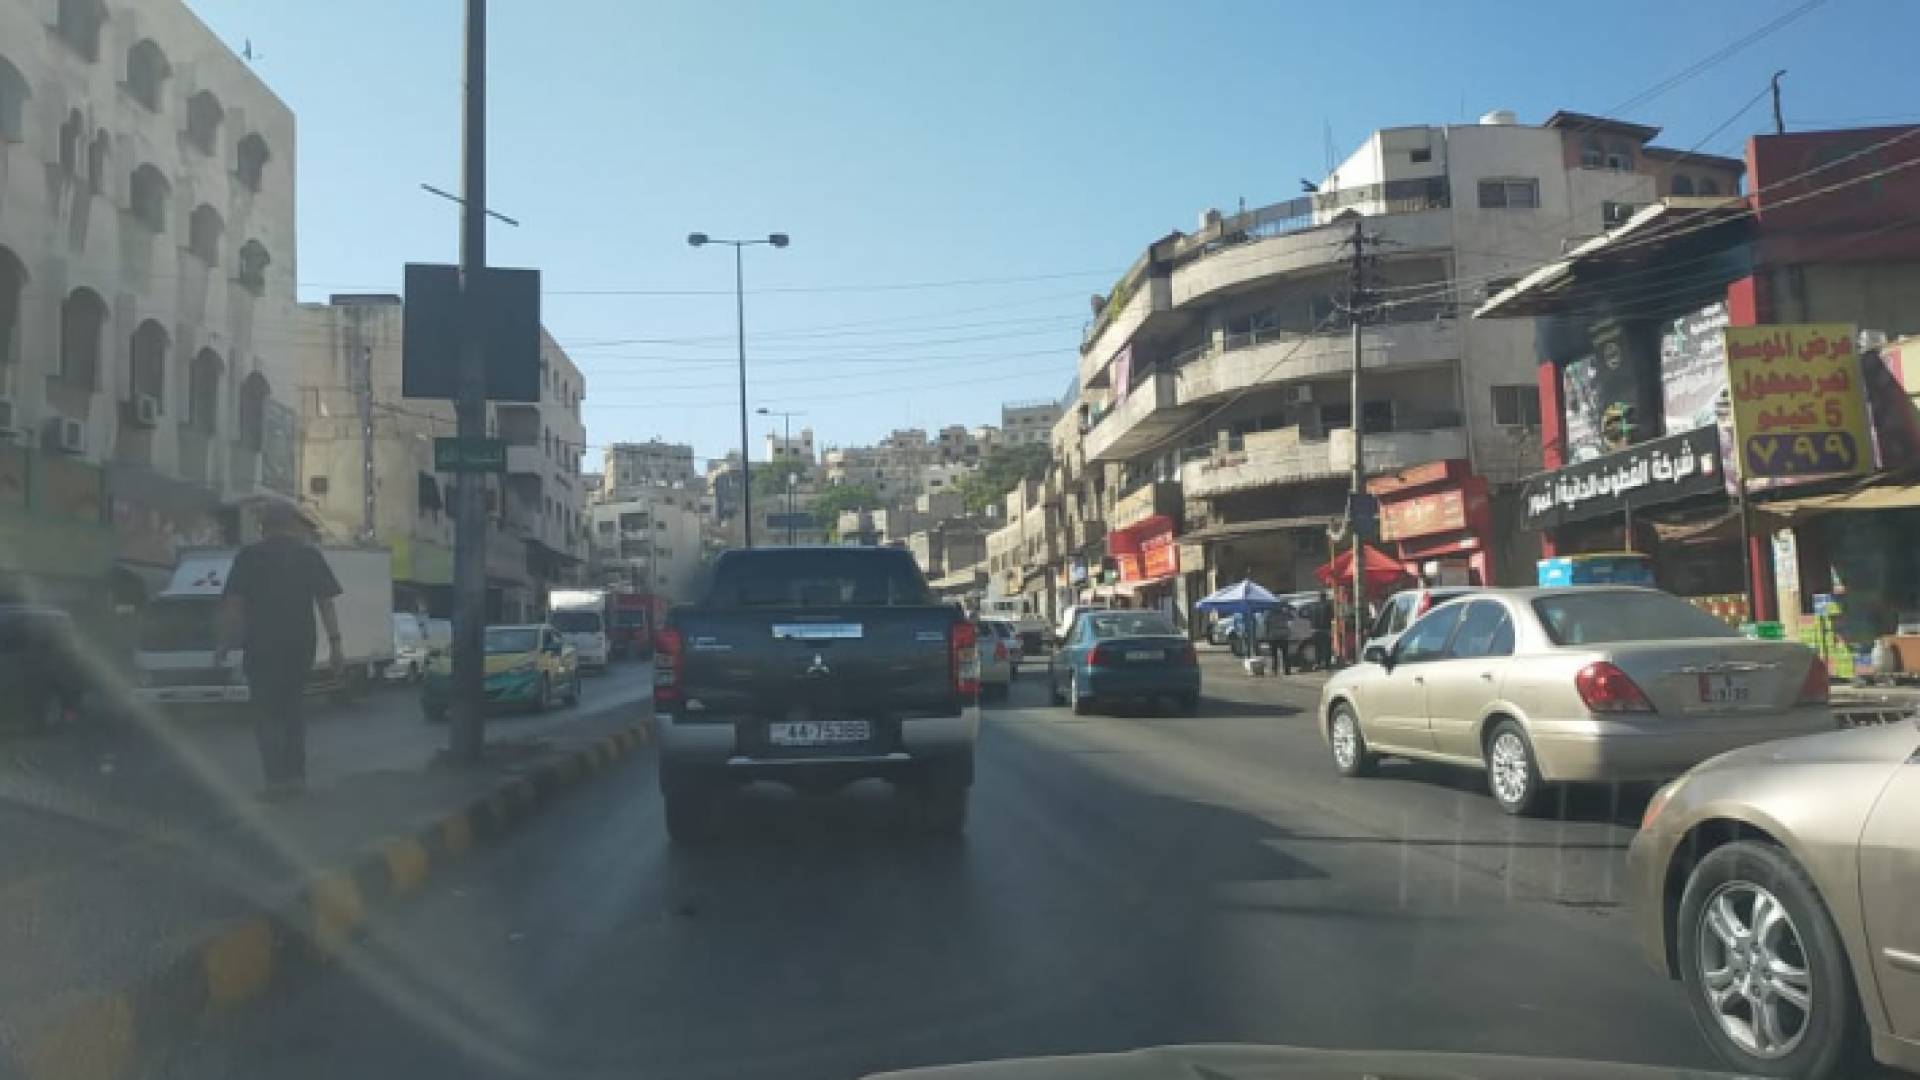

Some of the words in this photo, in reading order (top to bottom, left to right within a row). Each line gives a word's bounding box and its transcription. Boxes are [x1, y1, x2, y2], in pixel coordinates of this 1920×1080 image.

[1799, 328, 1852, 362] عرض
[1735, 368, 1812, 401] مجهول
[1815, 366, 1848, 398] تمر
[1757, 402, 1817, 430] كيلو
[1824, 398, 1841, 428] 5
[1651, 439, 1694, 484] شركة
